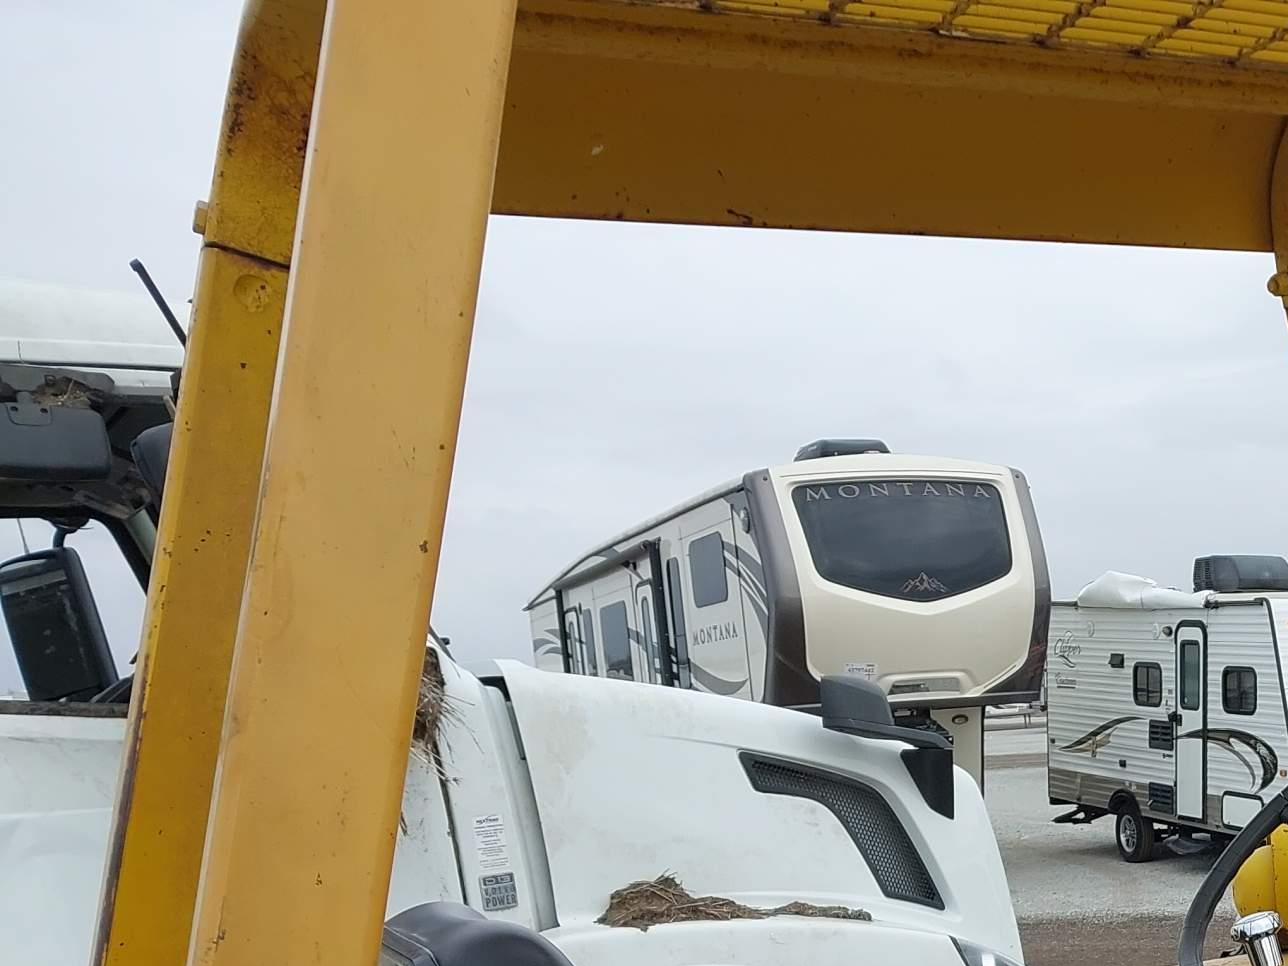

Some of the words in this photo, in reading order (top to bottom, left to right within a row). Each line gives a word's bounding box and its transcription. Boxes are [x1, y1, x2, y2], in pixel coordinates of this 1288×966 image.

[806, 482, 991, 502] MONTANA
[692, 621, 739, 647] MONTANA
[485, 893, 518, 908] POWER
